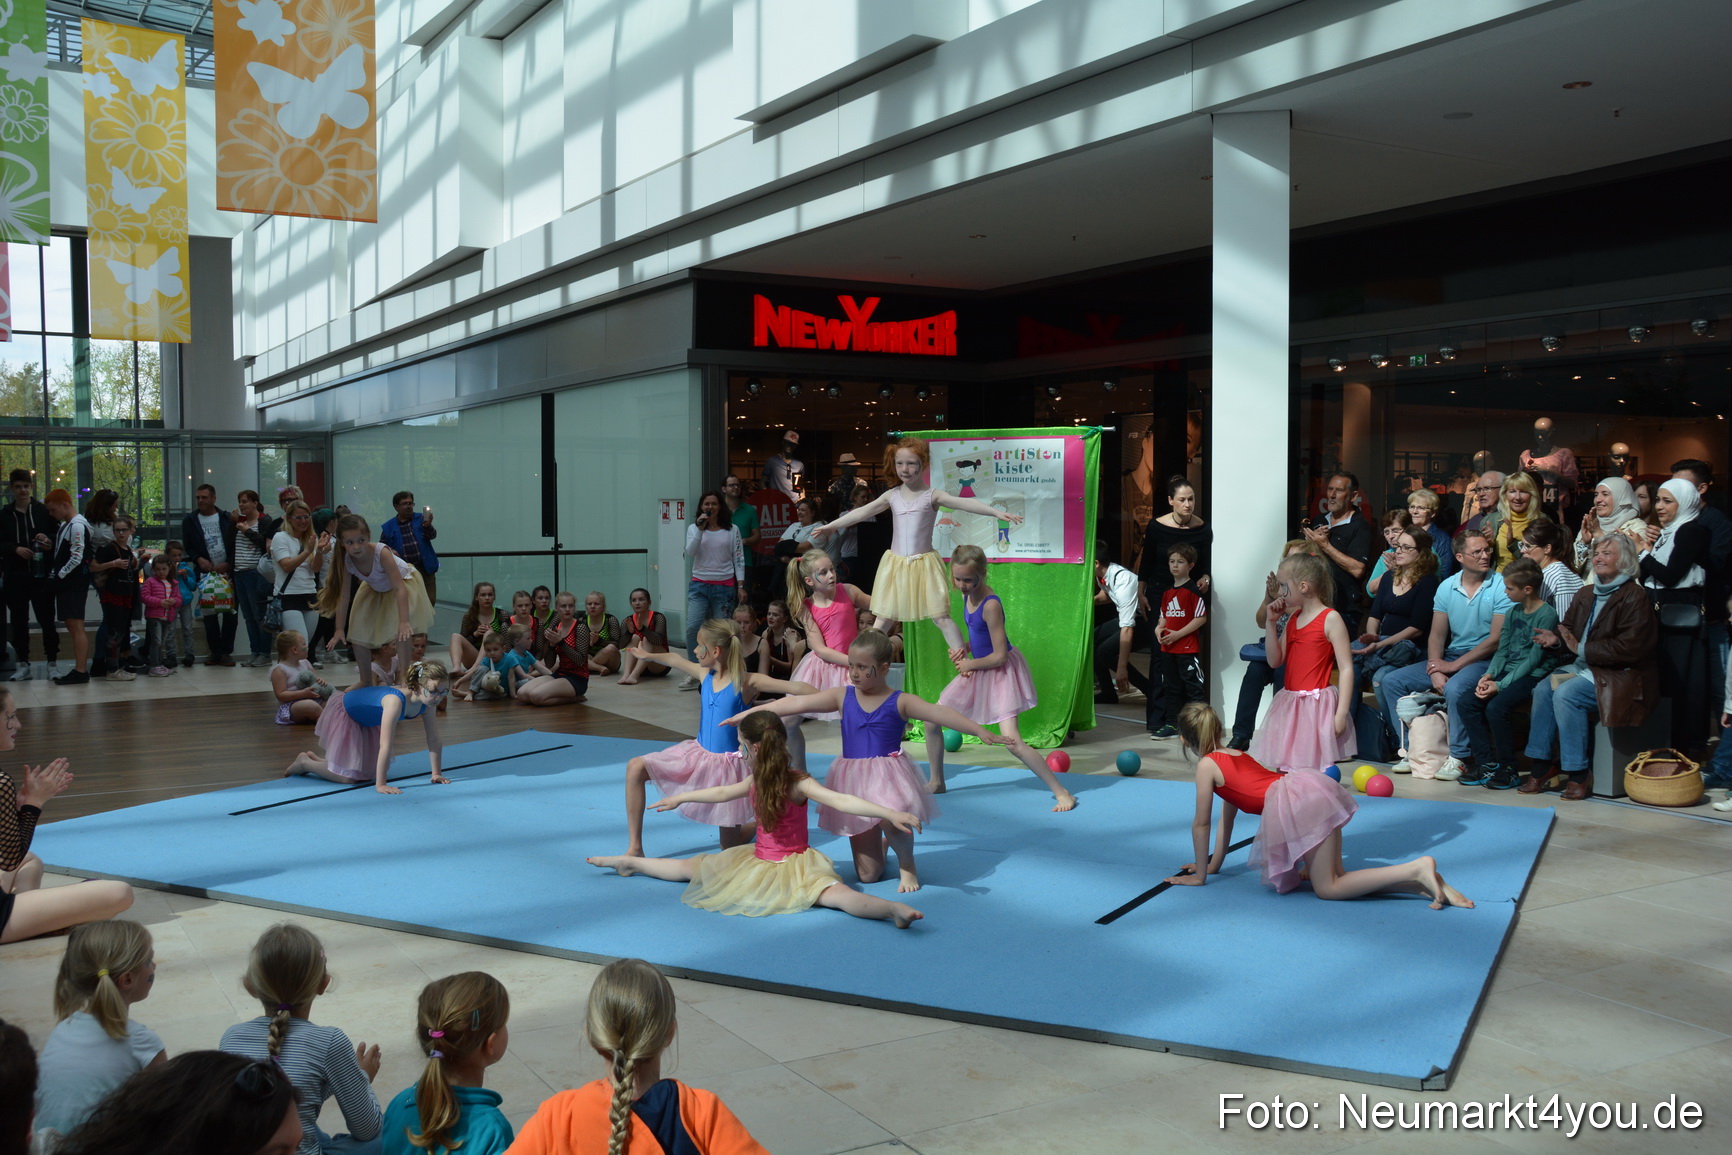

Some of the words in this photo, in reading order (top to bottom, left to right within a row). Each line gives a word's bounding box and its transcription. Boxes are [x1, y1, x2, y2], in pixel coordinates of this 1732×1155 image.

[995, 462, 1033, 474] kiste
[995, 475, 1040, 483] neumarkt
[753, 504, 791, 527] ALE
